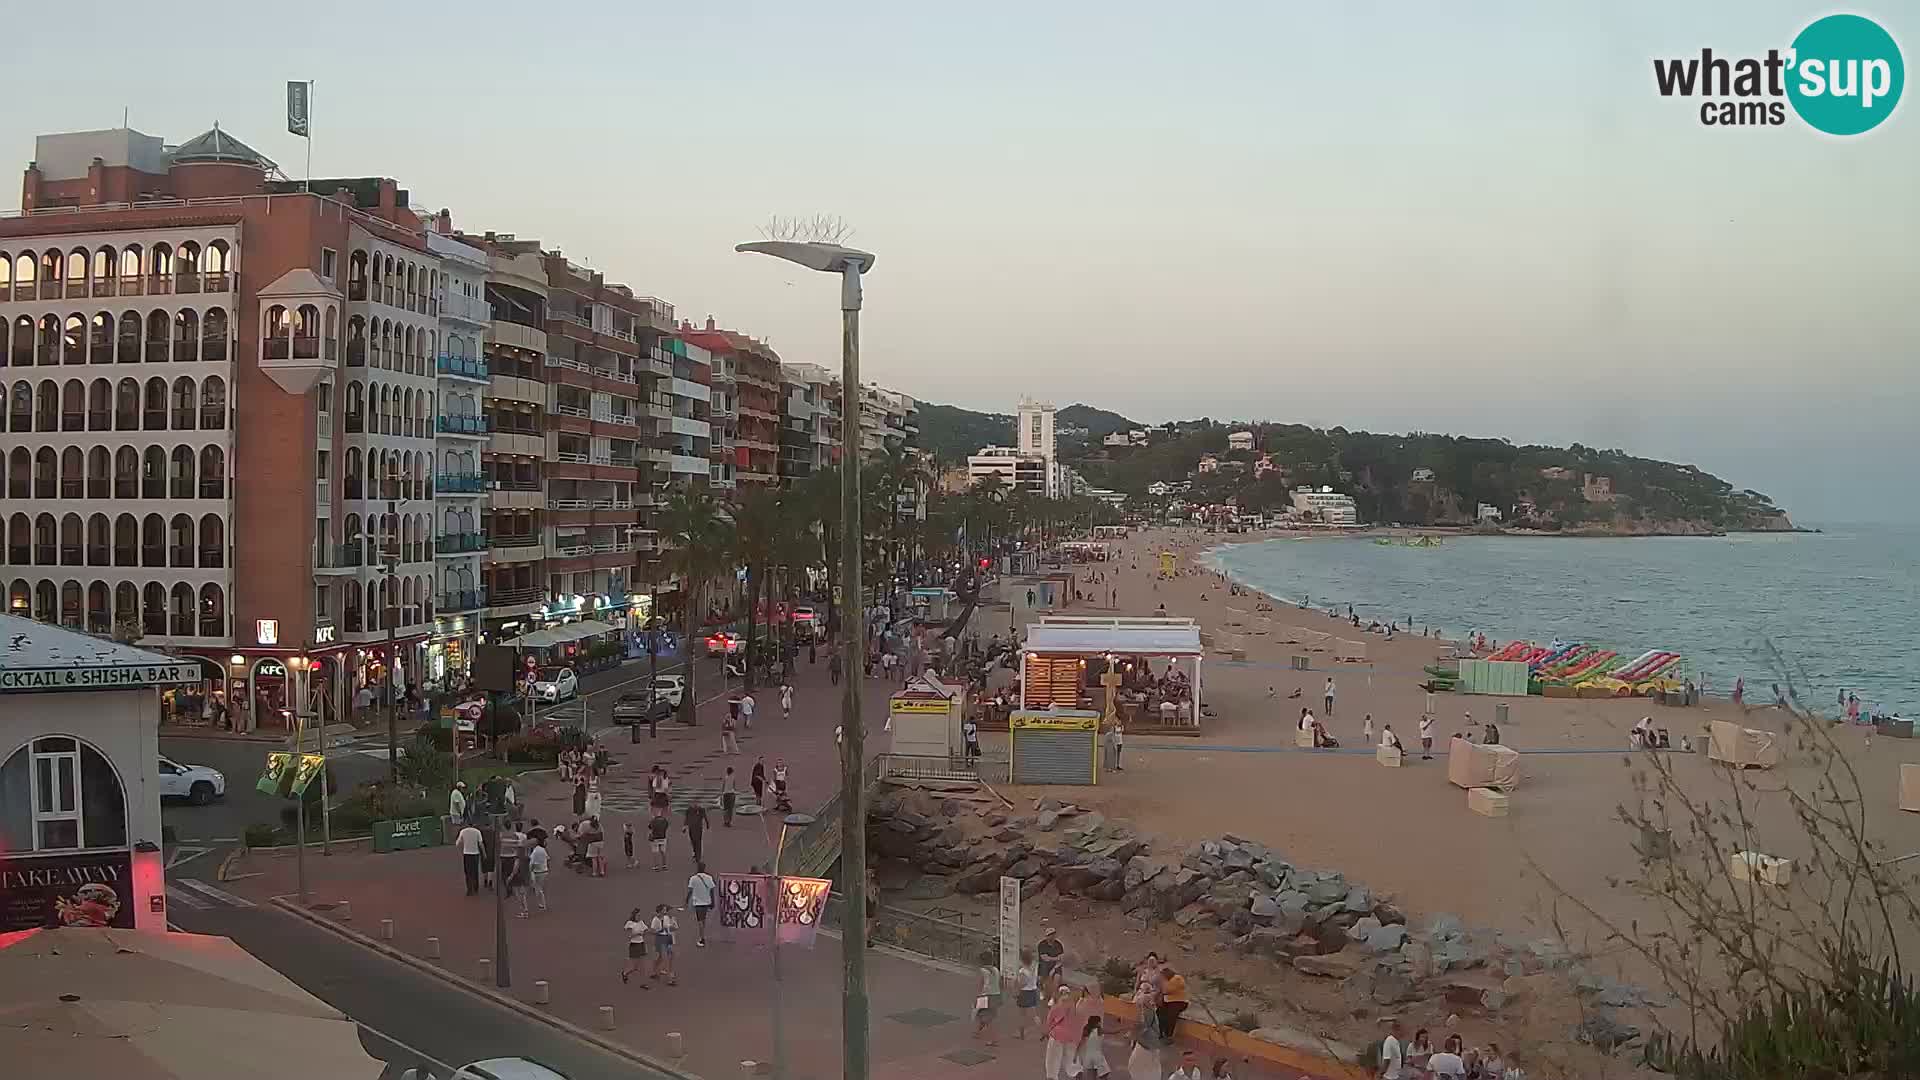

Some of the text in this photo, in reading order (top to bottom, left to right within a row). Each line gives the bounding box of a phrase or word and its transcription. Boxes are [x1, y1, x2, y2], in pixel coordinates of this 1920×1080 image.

[316, 626, 335, 643] KFC
[65, 671, 76, 684] &
[81, 668, 143, 684] SHISHA
[148, 667, 180, 681] BAR
[260, 666, 284, 675] KFC
[1, 864, 123, 889] TAKEAWAY
